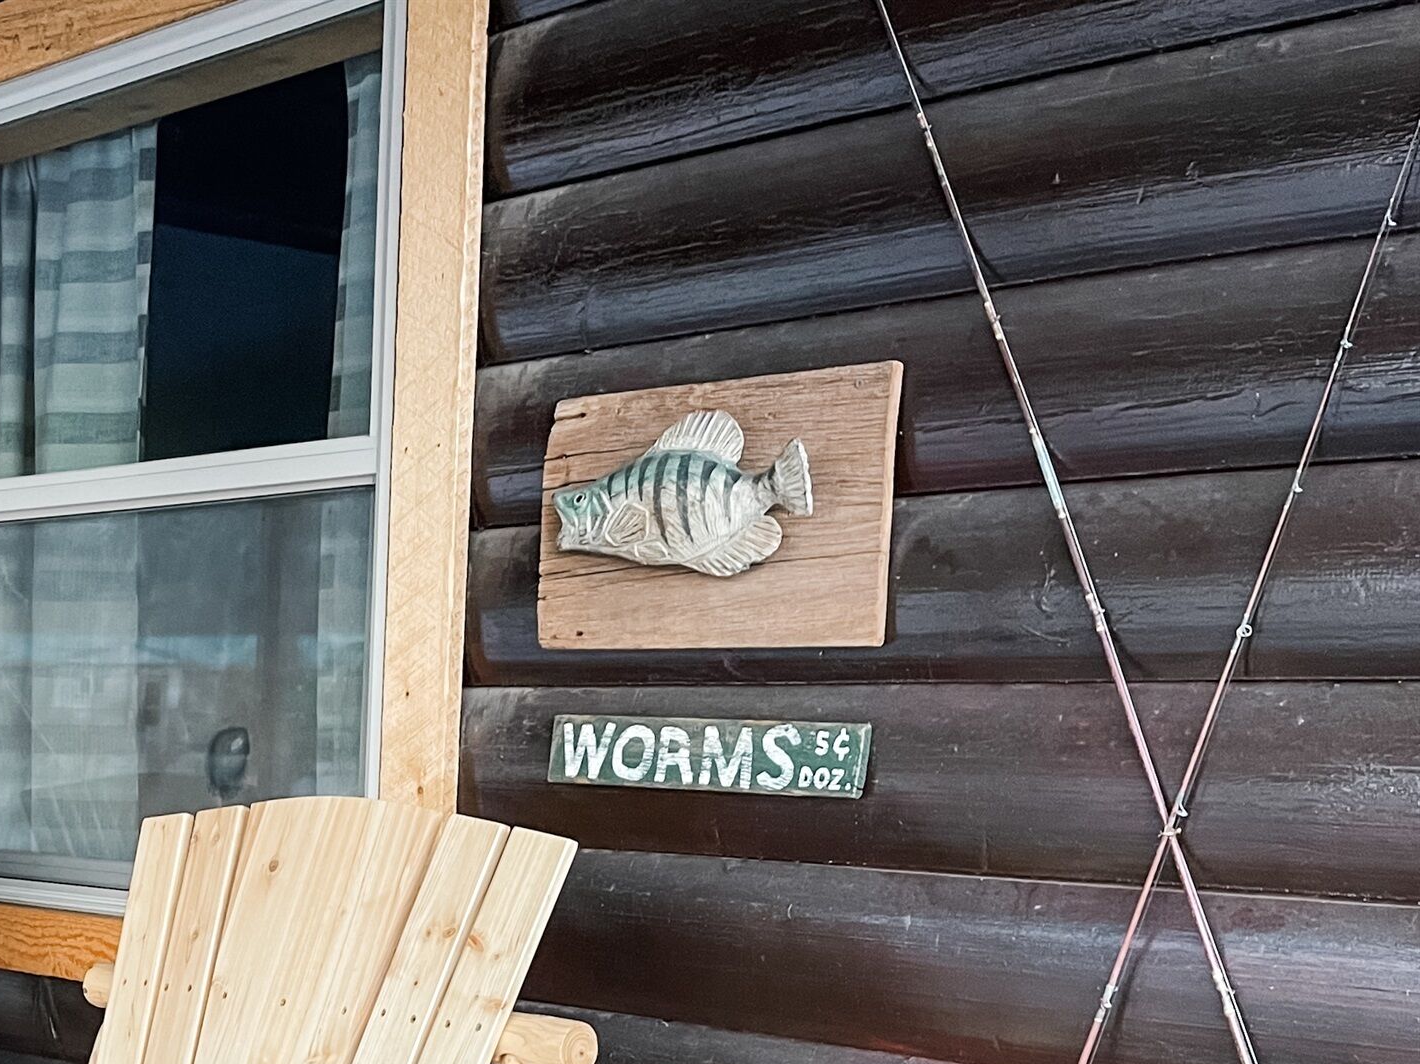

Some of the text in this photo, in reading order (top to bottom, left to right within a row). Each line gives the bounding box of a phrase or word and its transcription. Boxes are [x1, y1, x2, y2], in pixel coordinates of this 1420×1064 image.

[562, 721, 802, 790] WORMS
[813, 727, 850, 761] 5¢
[797, 766, 853, 791] DOZ.
